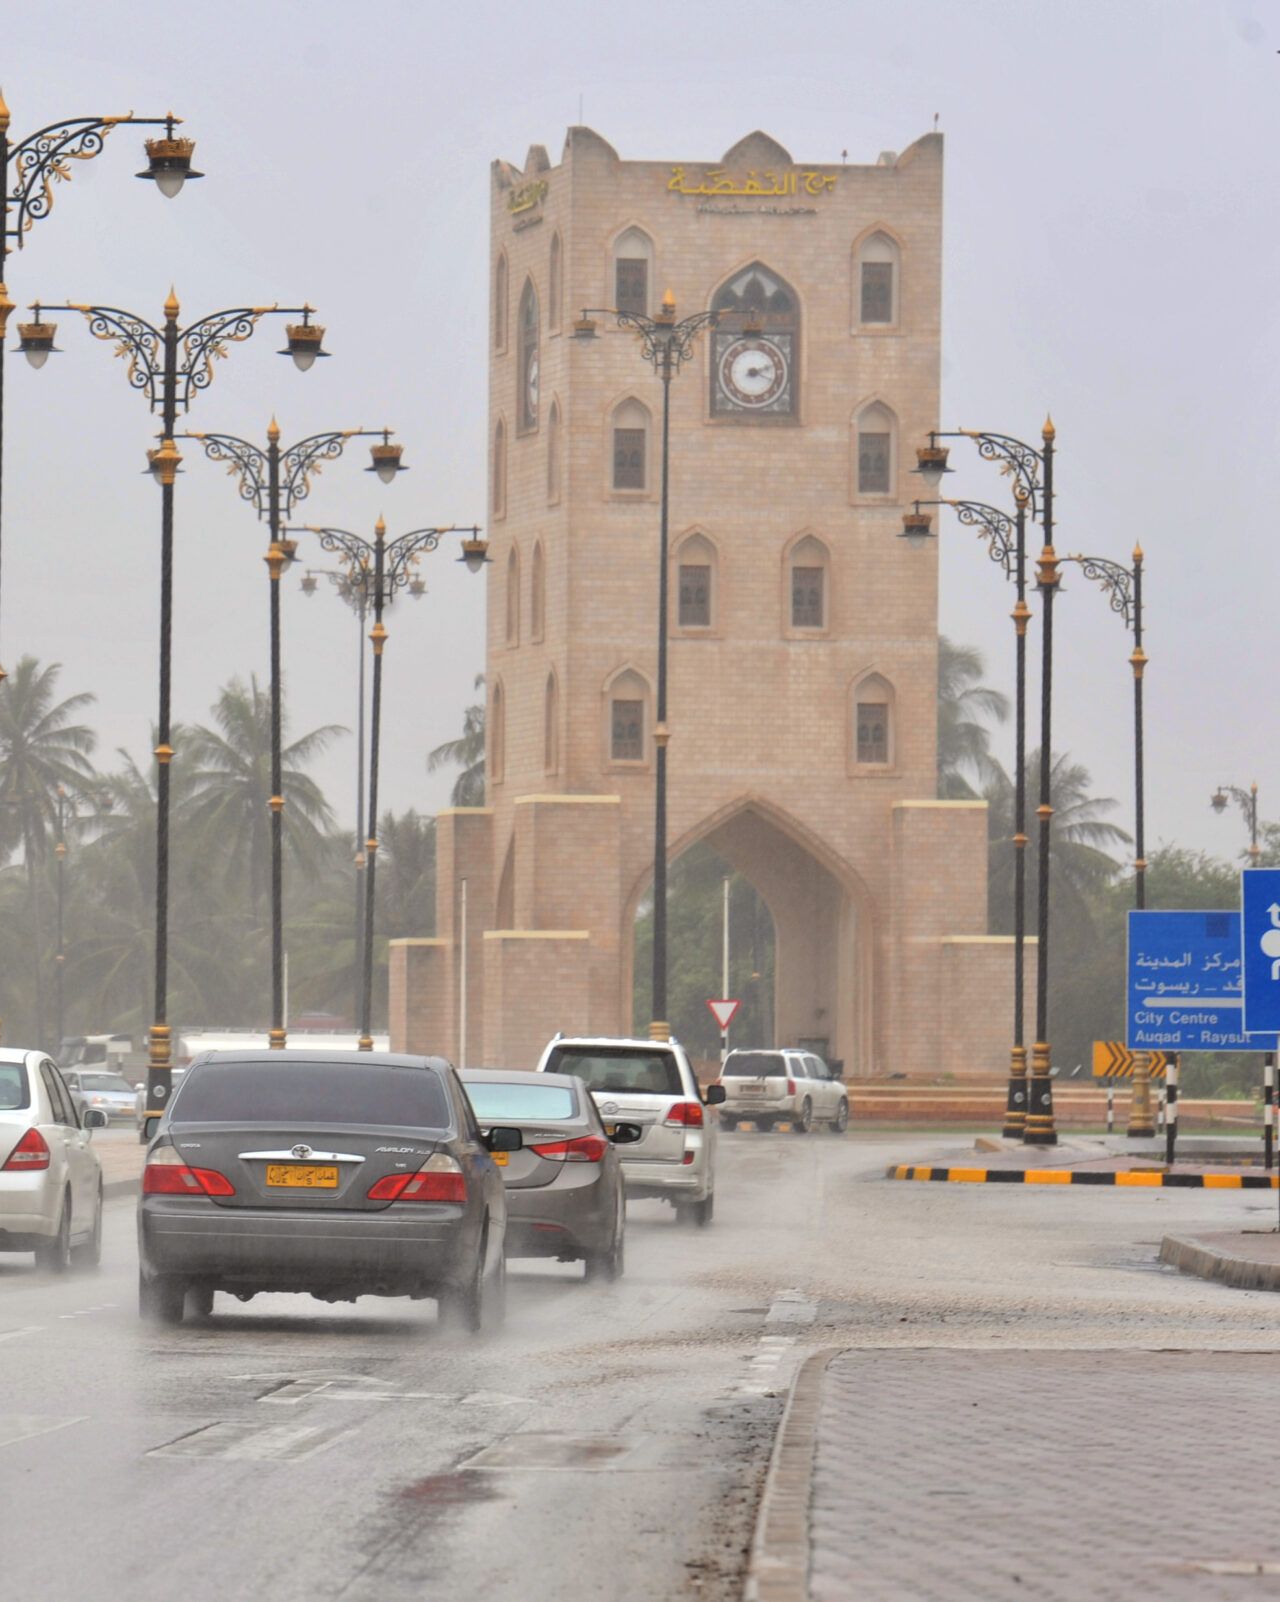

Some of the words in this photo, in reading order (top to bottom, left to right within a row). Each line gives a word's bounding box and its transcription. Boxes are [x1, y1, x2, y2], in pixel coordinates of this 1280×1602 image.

[1136, 952, 1192, 970] المدينة
[1201, 952, 1241, 971] مركز
[1134, 978, 1200, 994] ريسوت
[1135, 1011, 1164, 1026] City
[1169, 1011, 1218, 1024] Centre
[1135, 1029, 1181, 1044] Auqad
